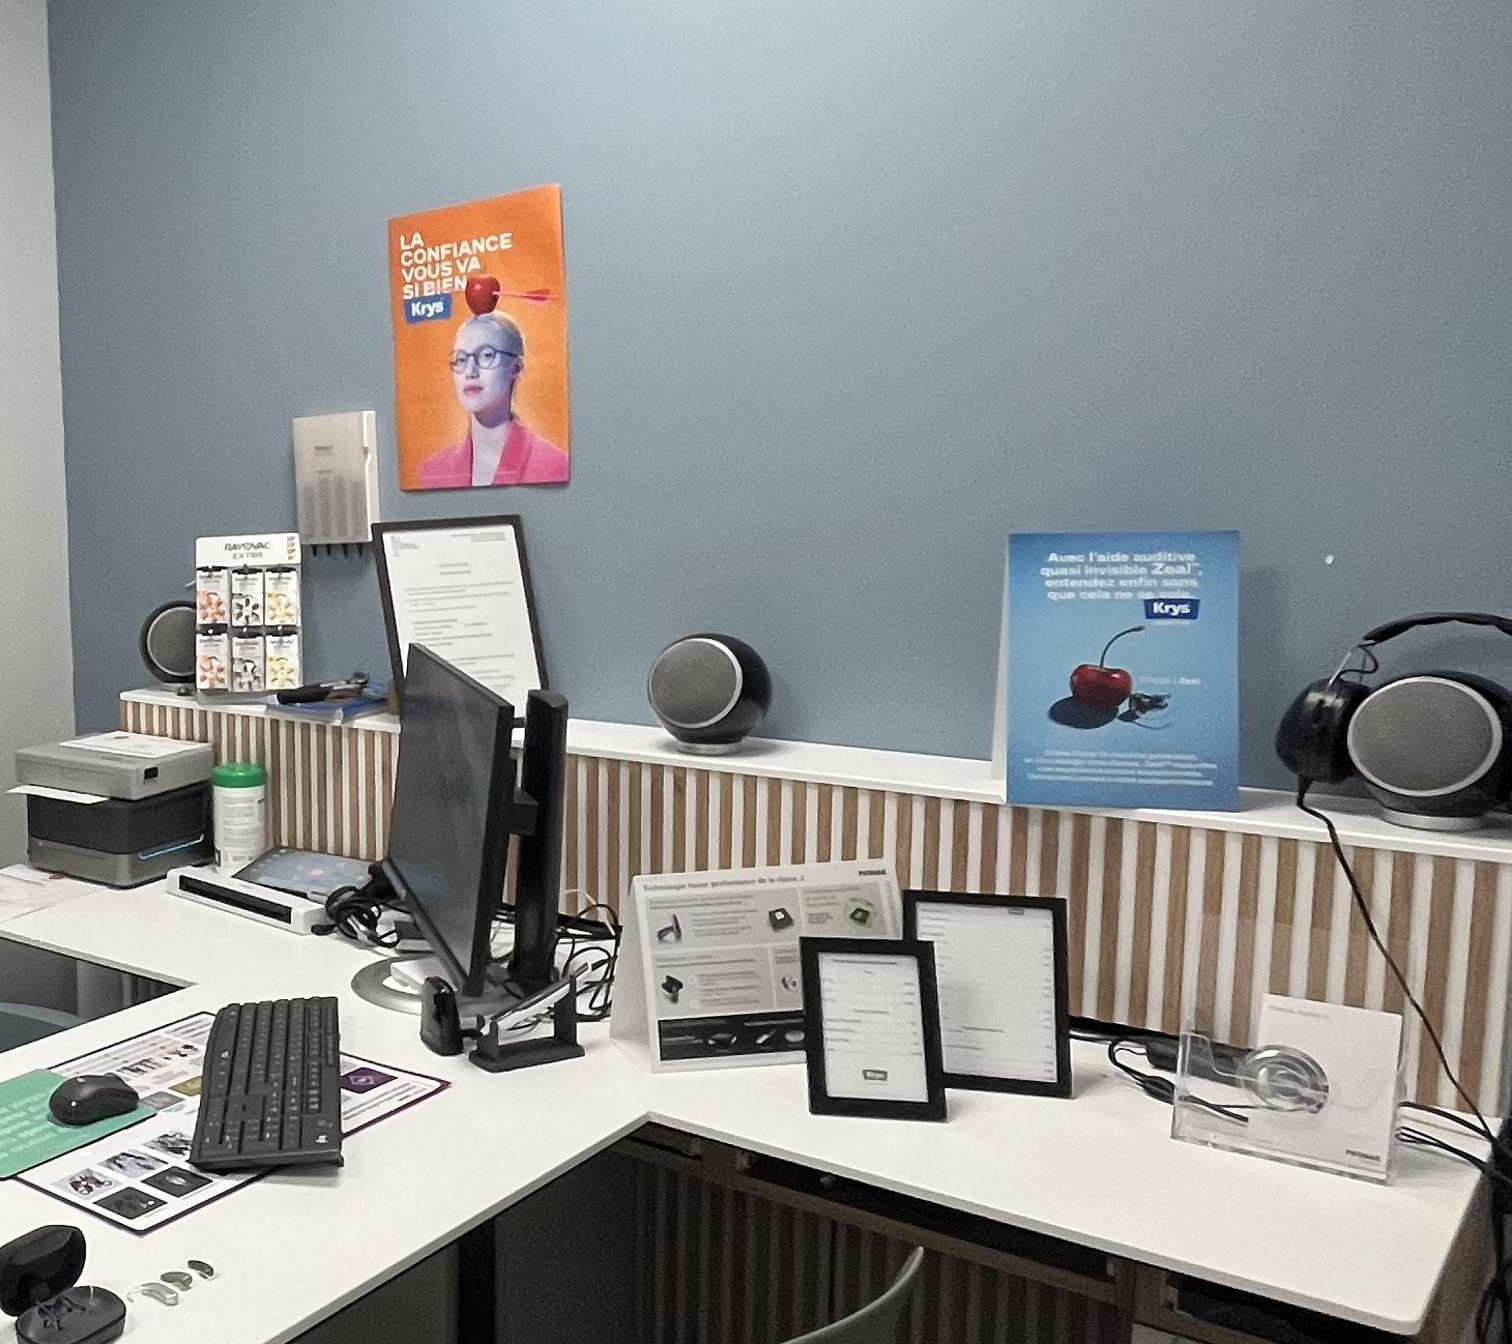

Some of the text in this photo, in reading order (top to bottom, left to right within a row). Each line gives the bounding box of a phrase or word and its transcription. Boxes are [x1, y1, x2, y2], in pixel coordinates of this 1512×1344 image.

[399, 232, 424, 250] LA
[400, 232, 513, 267] CONFIANCE
[401, 256, 481, 283] VOUS VA
[403, 275, 468, 300] SI BIEN
[411, 301, 444, 318] Krys
[224, 541, 272, 553] RAYOVAC
[1047, 550, 1197, 563] Avec l'aide auditive
[1040, 565, 1082, 578] quasi
[1084, 564, 1148, 576] invisible
[1044, 577, 1199, 588] entendez enfin sans
[1047, 590, 1076, 601] que
[1079, 589, 1111, 600] cela
[1114, 590, 1134, 600] ne
[1153, 602, 1191, 616] Krys
